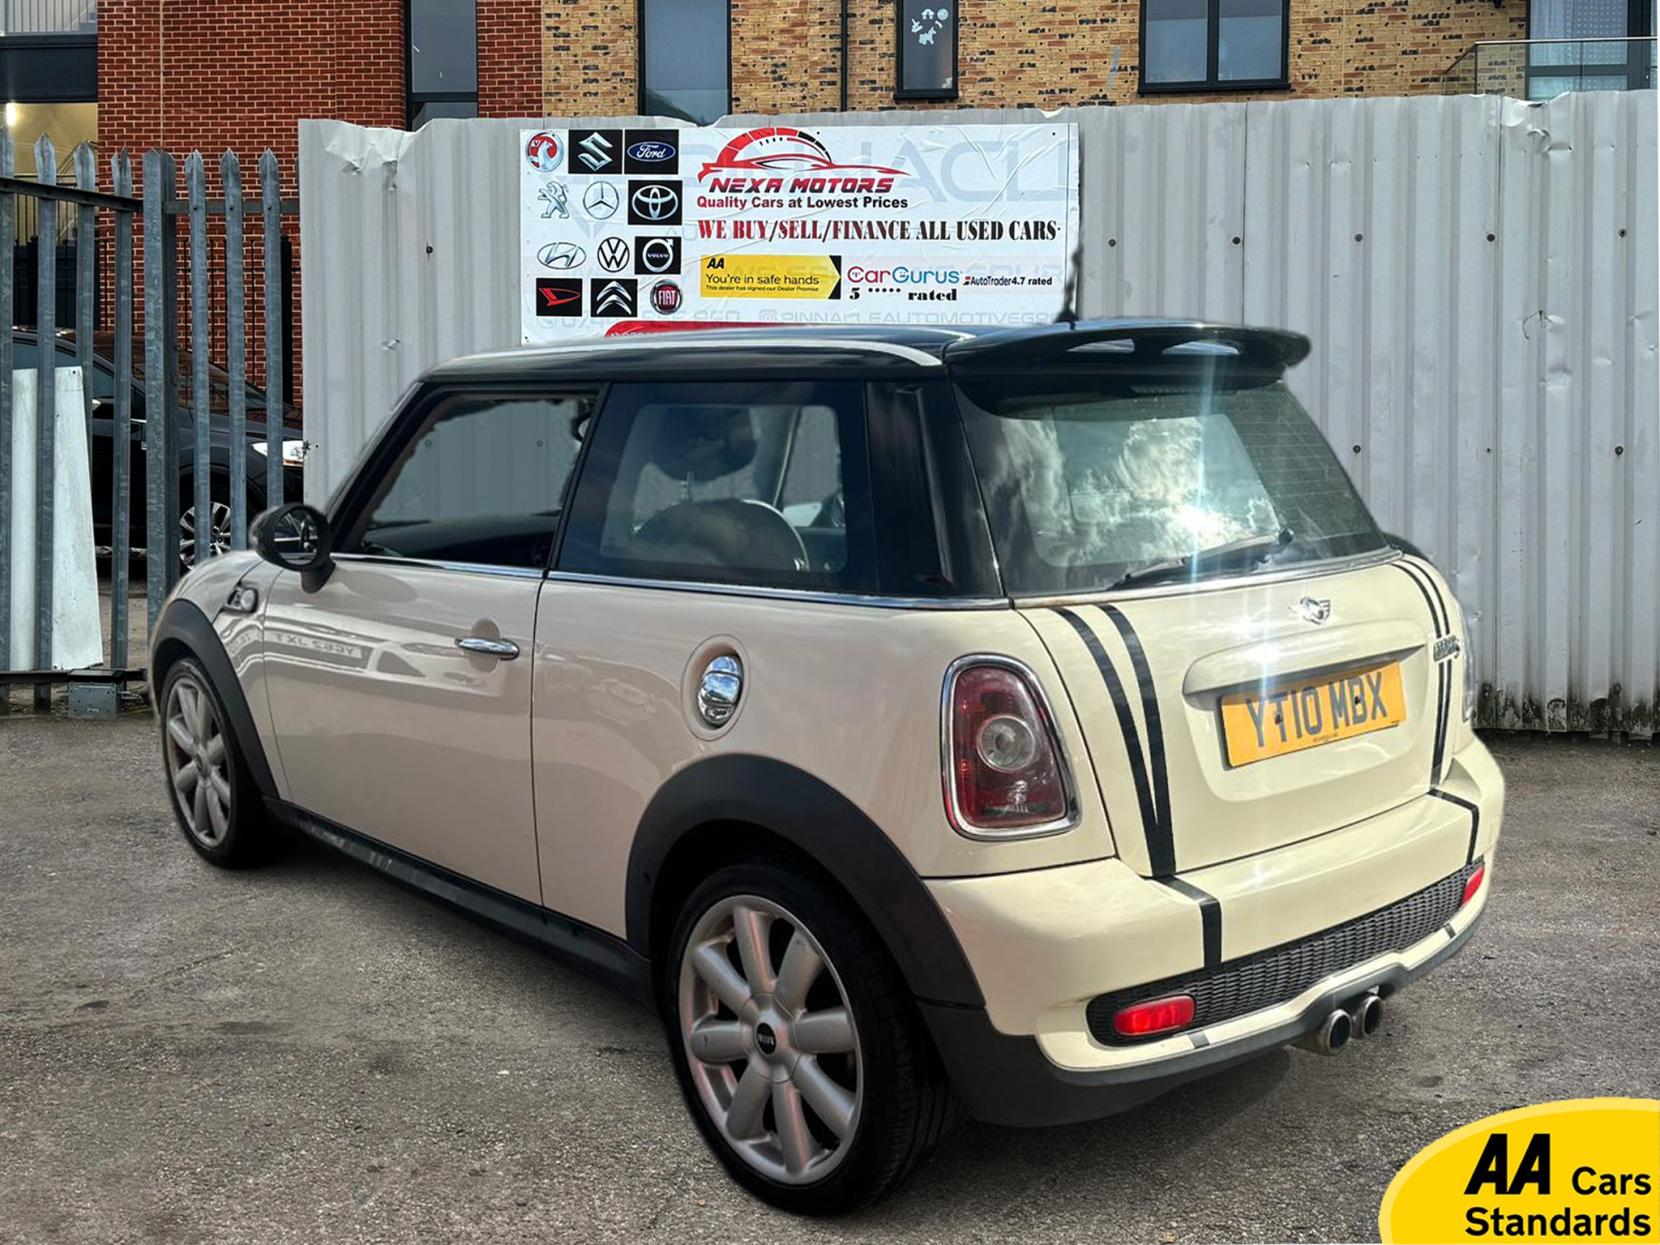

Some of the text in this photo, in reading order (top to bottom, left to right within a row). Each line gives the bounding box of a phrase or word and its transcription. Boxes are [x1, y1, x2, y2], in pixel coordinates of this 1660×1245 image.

[636, 144, 667, 159] Ford
[709, 178, 894, 194] NEXA MOTORS
[697, 195, 908, 211] Quality Cars at Lowest Prices
[698, 220, 727, 240] WE
[916, 220, 951, 241] ALL
[956, 220, 1004, 241] USED
[1008, 220, 1057, 241] CARS
[706, 257, 725, 269] AA
[706, 273, 820, 285] You're in safe hands
[847, 265, 960, 284] CarGurus
[1027, 276, 1053, 286] rated
[658, 290, 677, 306] FIAT
[849, 287, 958, 301] 5 rated
[1245, 671, 1388, 748] YT10 MBX
